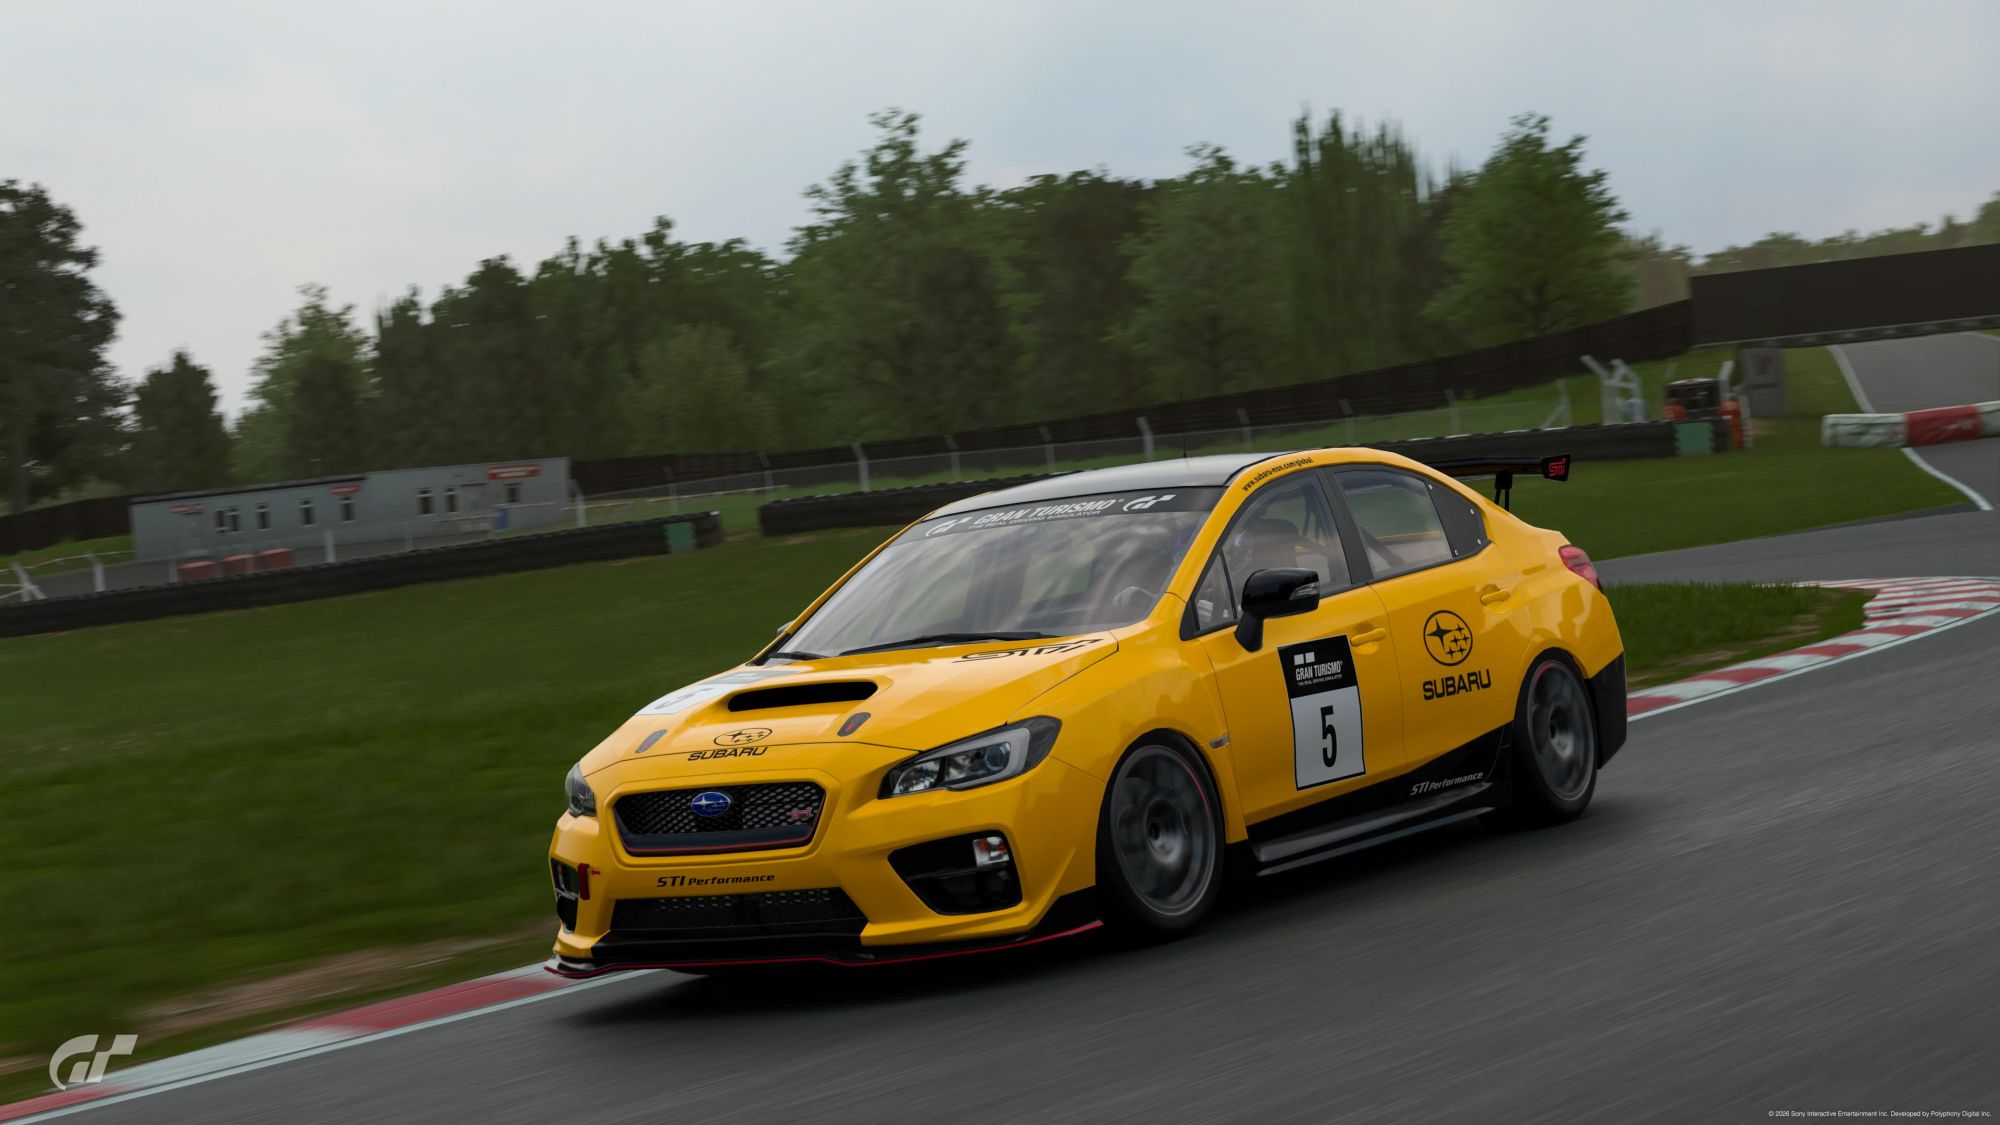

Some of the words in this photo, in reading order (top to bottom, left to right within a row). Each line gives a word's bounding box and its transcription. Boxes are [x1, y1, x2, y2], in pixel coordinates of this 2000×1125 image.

[973, 509, 1030, 525] GRAN
[1295, 666, 1313, 681] GRAN
[1422, 669, 1491, 701] SUBARU
[1320, 705, 1337, 767] 5
[688, 746, 768, 761] SUBARU
[1410, 781, 1429, 796] STI
[1429, 771, 1484, 791] Performance
[657, 875, 686, 888] STI
[688, 874, 775, 886] Performance
